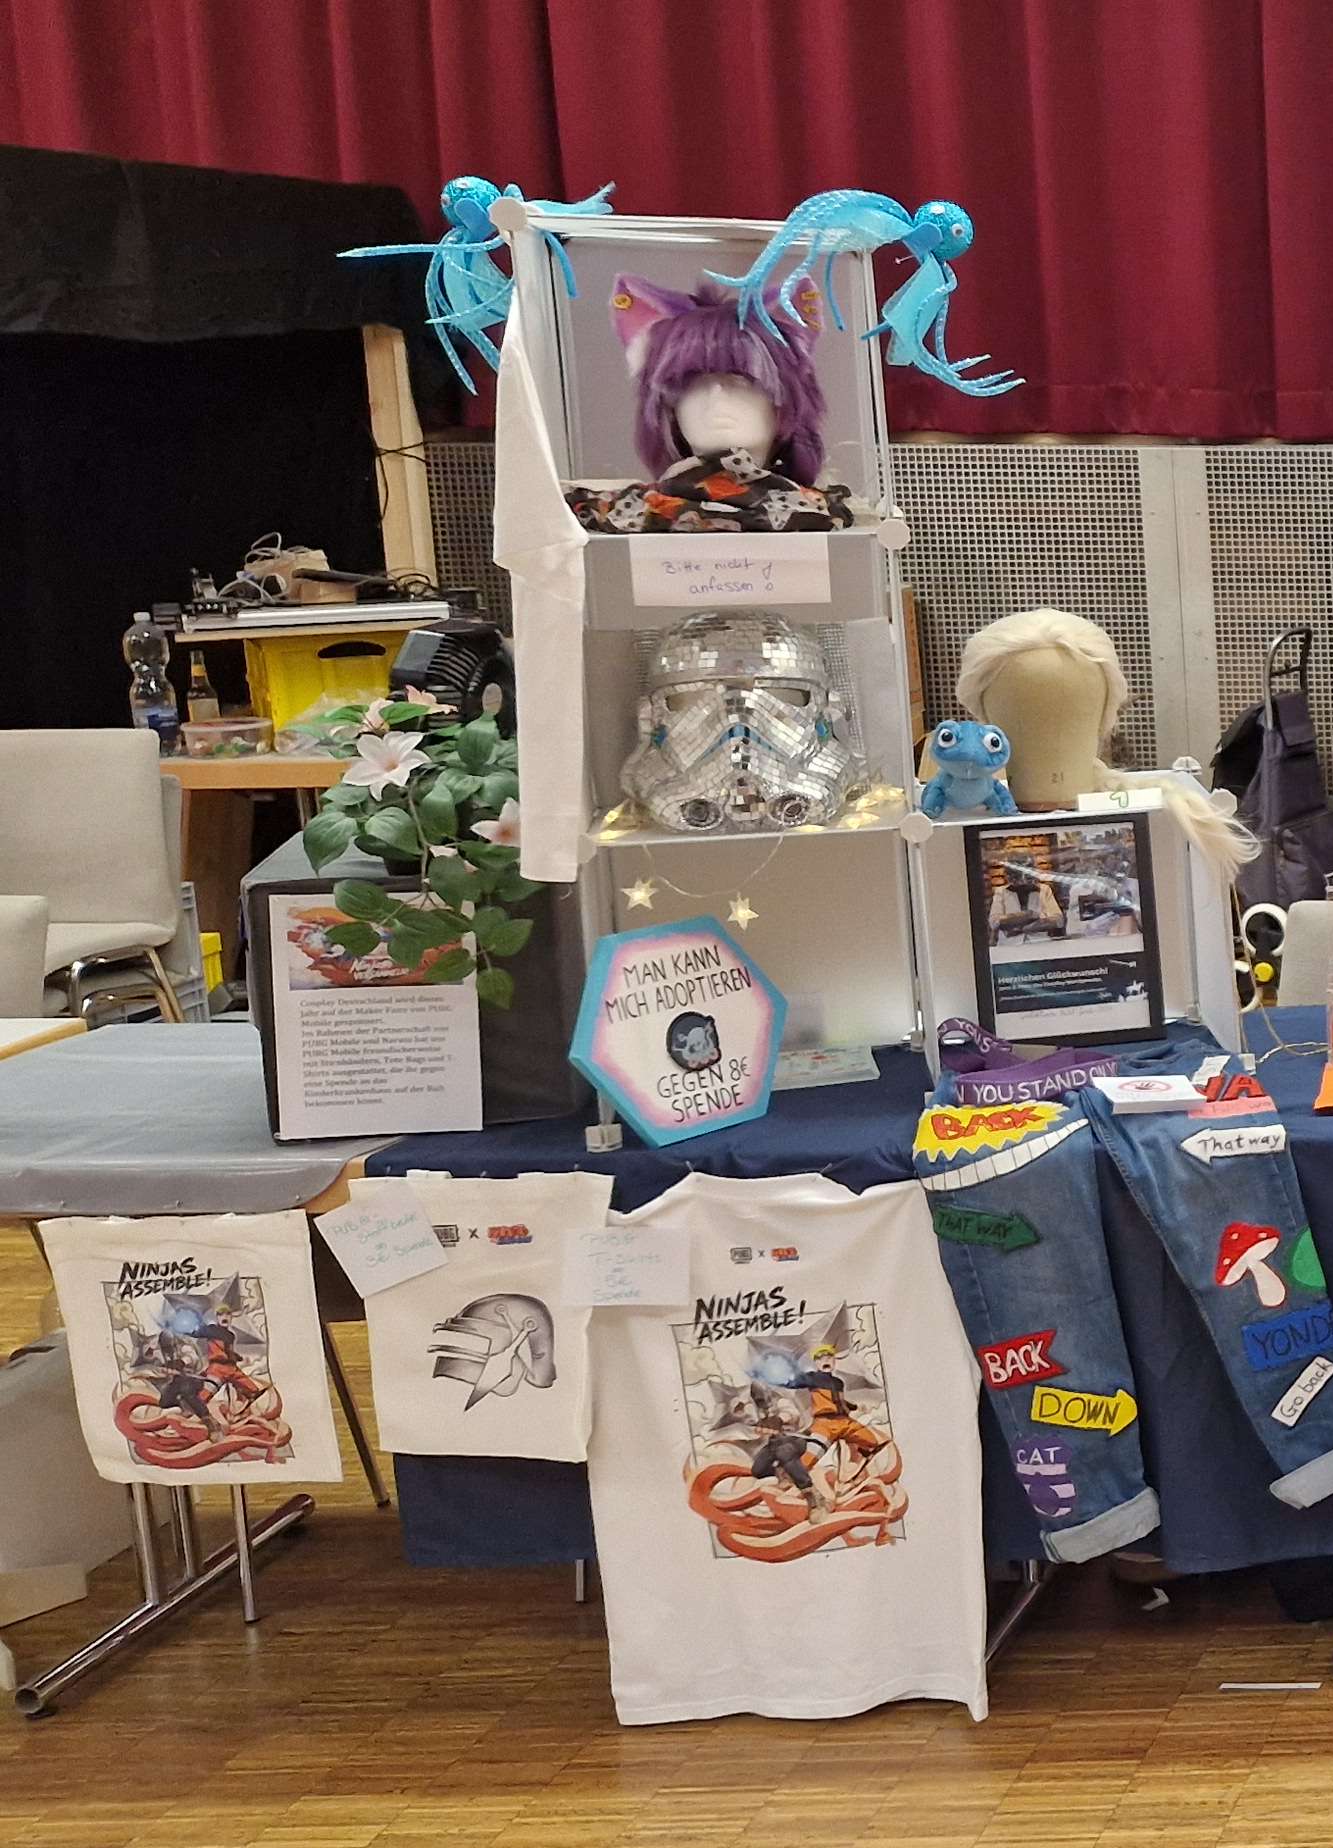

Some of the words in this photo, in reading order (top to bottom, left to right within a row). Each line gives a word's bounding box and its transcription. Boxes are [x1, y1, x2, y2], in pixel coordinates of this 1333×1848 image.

[662, 561, 701, 575] Bitte
[713, 558, 755, 572] nicht
[688, 577, 754, 595] anfassen
[622, 958, 667, 988] MAN
[671, 945, 721, 977] KANN
[605, 990, 650, 1024] MICH
[655, 966, 752, 1013] ADOPTIEREN
[656, 1063, 724, 1099] GEGEN
[728, 1055, 751, 1082] 8€
[972, 1083, 1014, 1104] YOU
[1016, 1068, 1088, 1100] STAND
[671, 1083, 744, 1123] SPENDE
[930, 1106, 1043, 1141] BACK
[1200, 1136, 1247, 1151] That
[1249, 1134, 1282, 1151] way
[118, 1256, 198, 1290] NINJAS
[120, 1267, 213, 1301] ASSEMBLE!
[693, 1285, 788, 1335] NINJAS
[697, 1299, 807, 1345] ASSEMBLE!
[983, 1337, 1053, 1386] BACK
[1278, 1393, 1305, 1419] Go
[1301, 1359, 1333, 1395] back
[1038, 1391, 1121, 1426] DOWN
[1016, 1445, 1058, 1466] CAT
